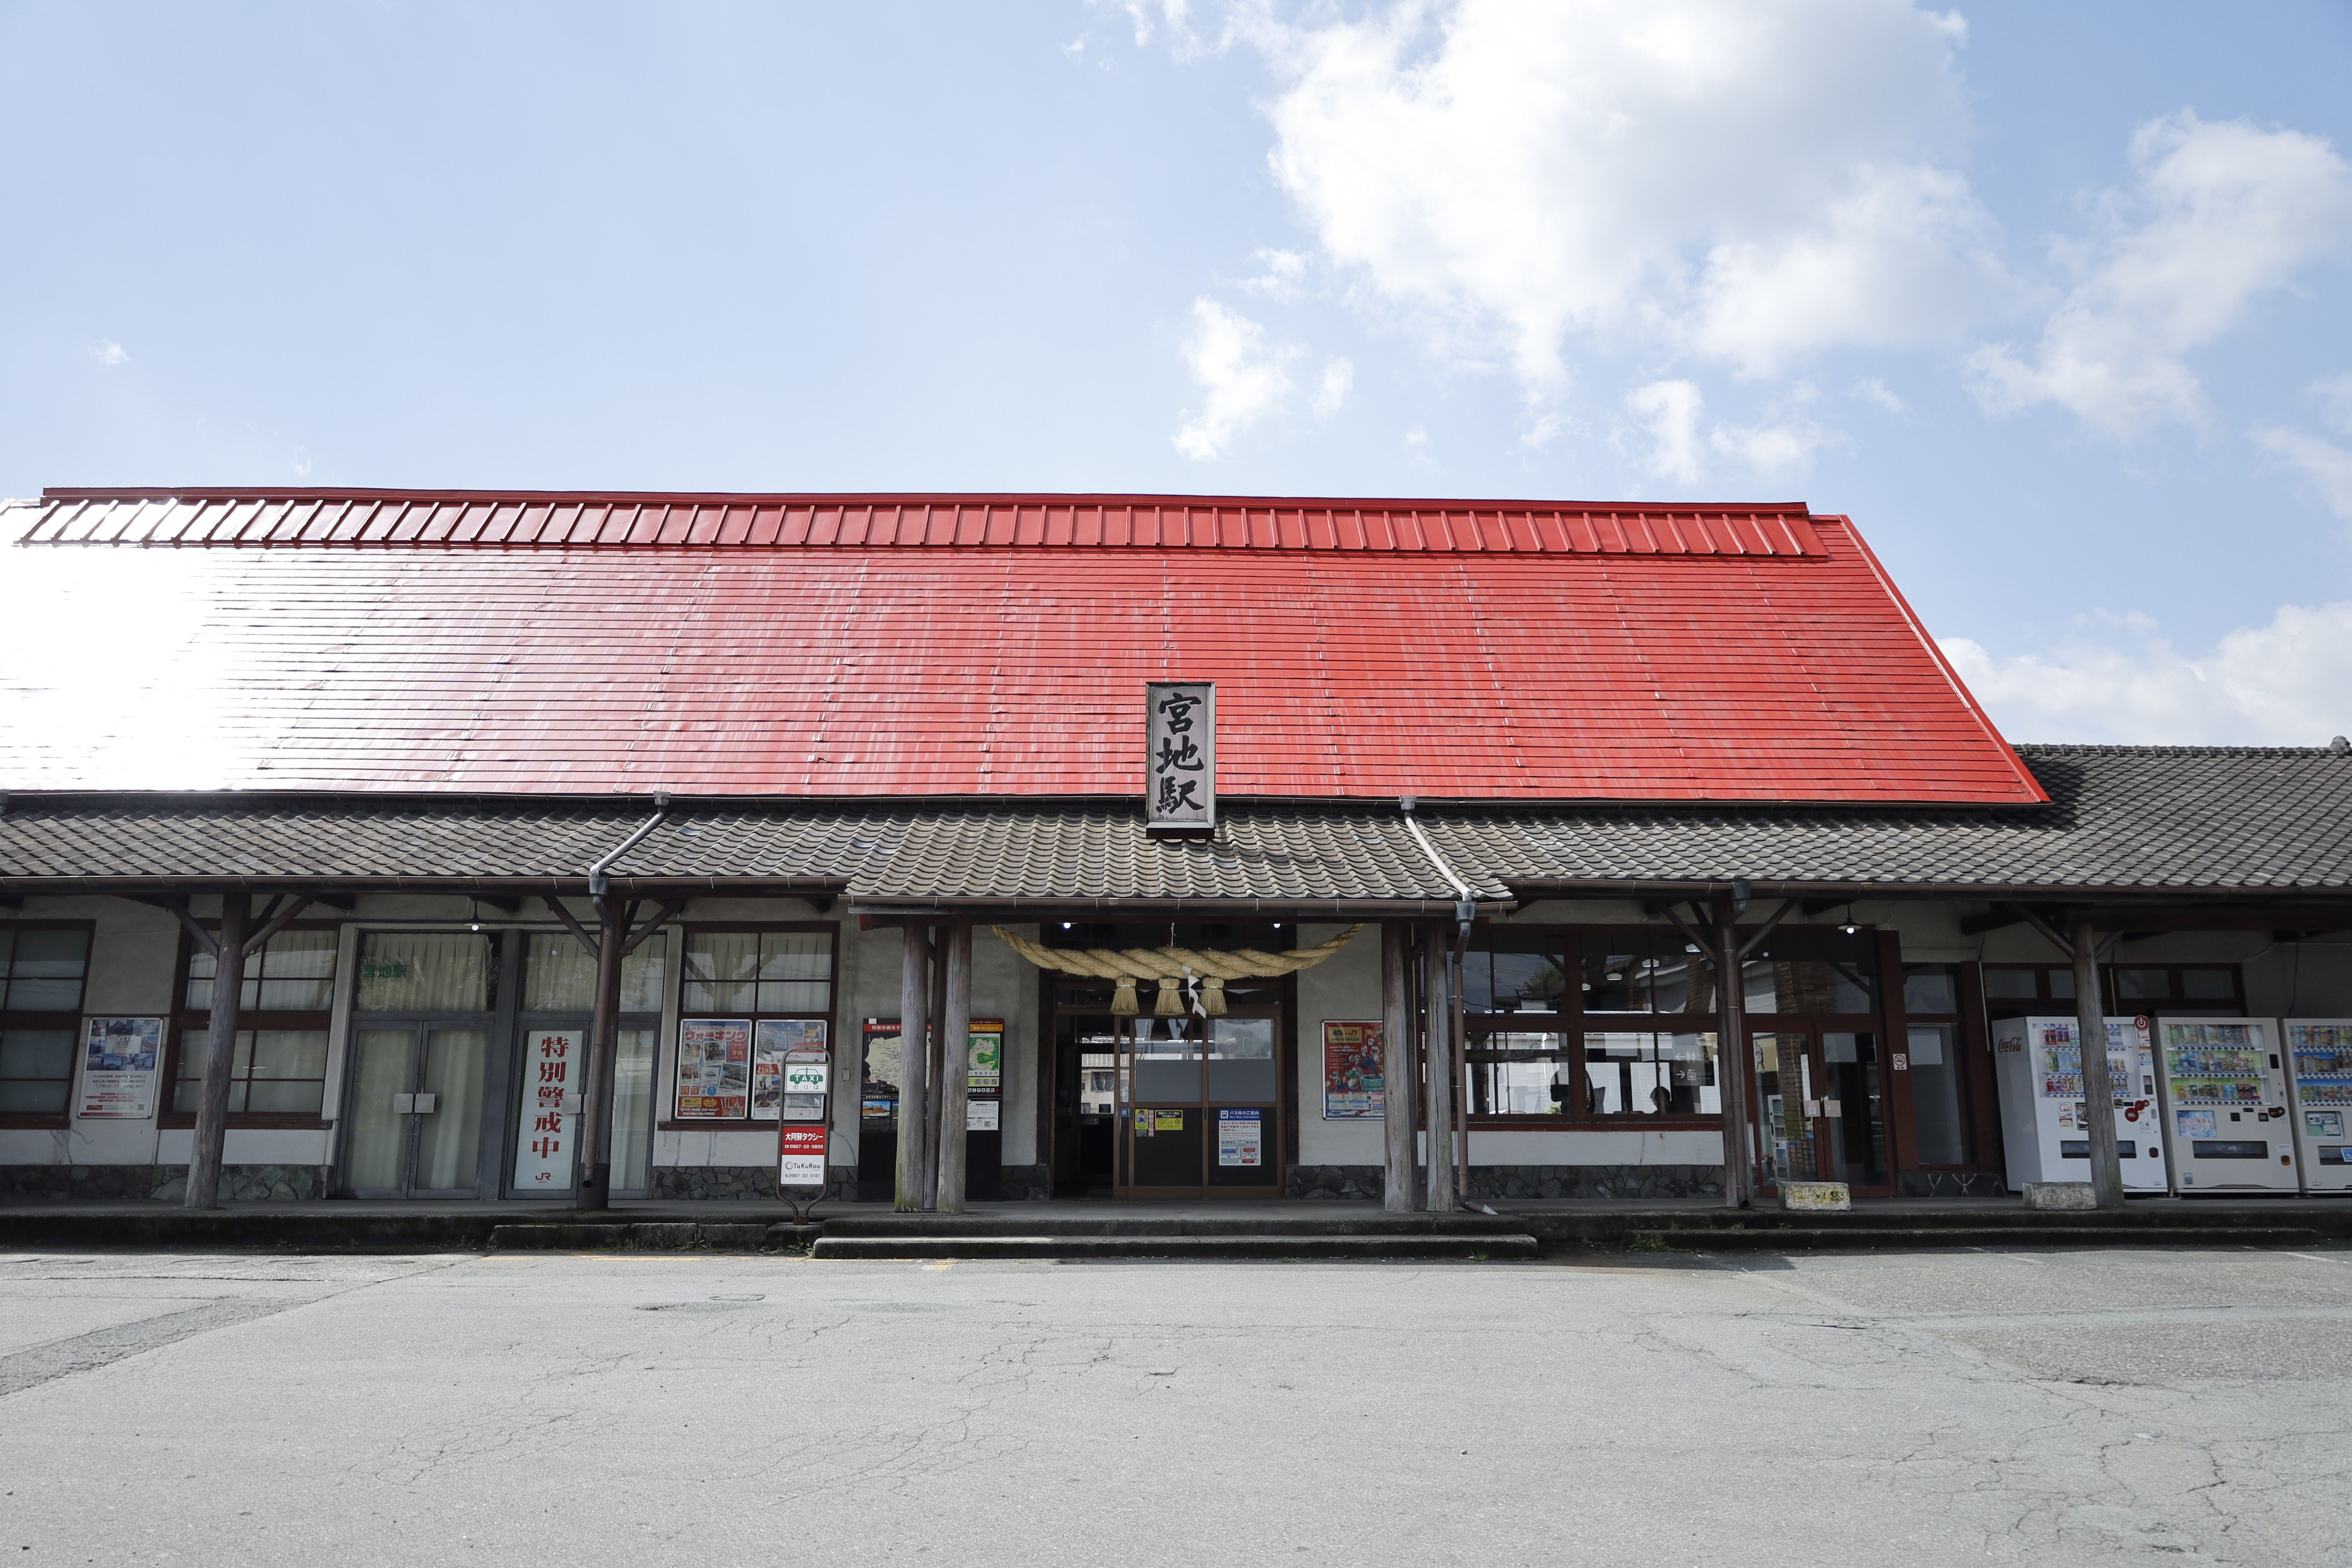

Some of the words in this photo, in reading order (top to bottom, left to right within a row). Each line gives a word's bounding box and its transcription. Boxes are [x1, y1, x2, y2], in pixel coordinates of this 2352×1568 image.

[1155, 692, 1204, 814] 宮地駅
[364, 964, 407, 978] 宮地駅
[685, 1031, 747, 1041] ウォーキング
[532, 1036, 569, 1159] 特別警戒中
[785, 1132, 824, 1141] 大阿蘇タクシー
[535, 1173, 551, 1181] JR
